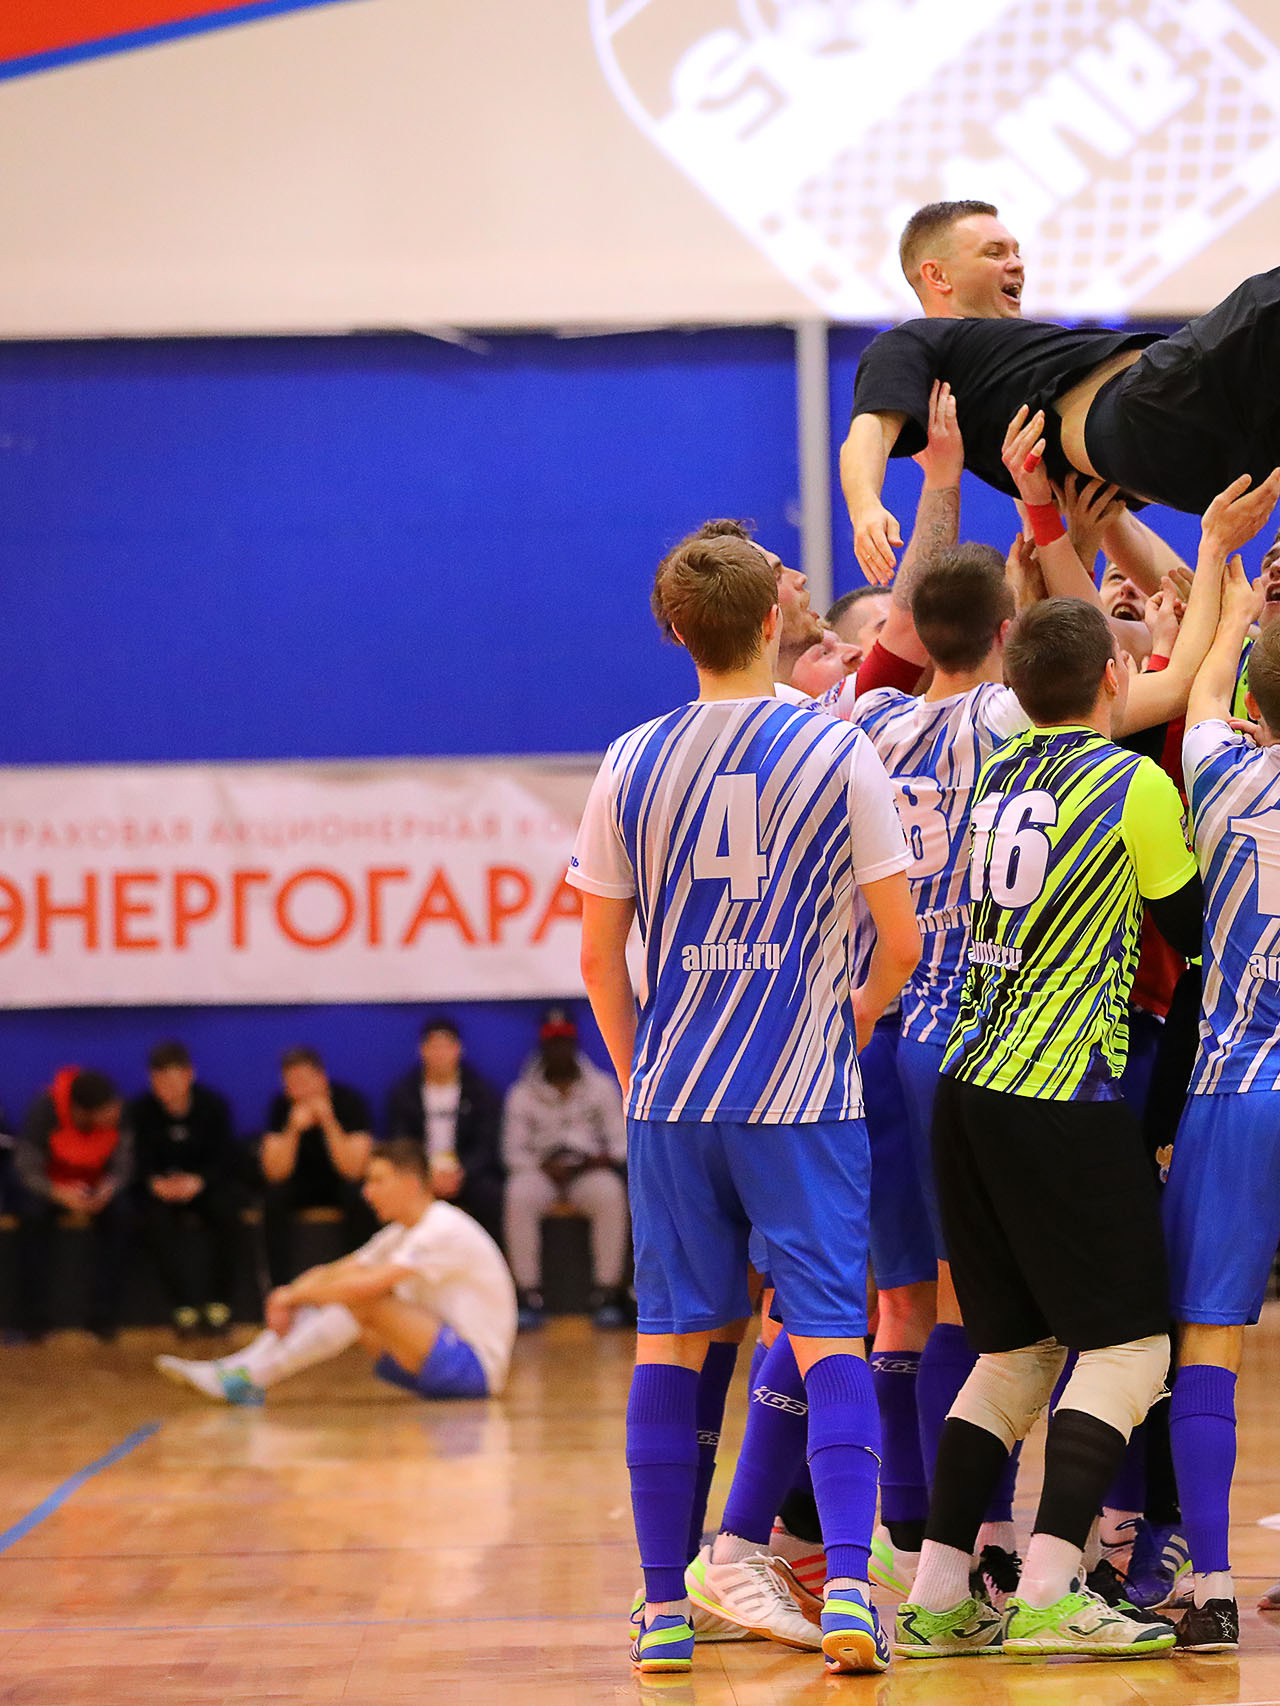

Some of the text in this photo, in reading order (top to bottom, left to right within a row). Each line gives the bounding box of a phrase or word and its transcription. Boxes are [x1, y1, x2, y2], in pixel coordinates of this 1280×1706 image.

[692, 770, 769, 903] 4
[970, 788, 1057, 909] 16
[681, 939, 781, 972] amfr.ru
